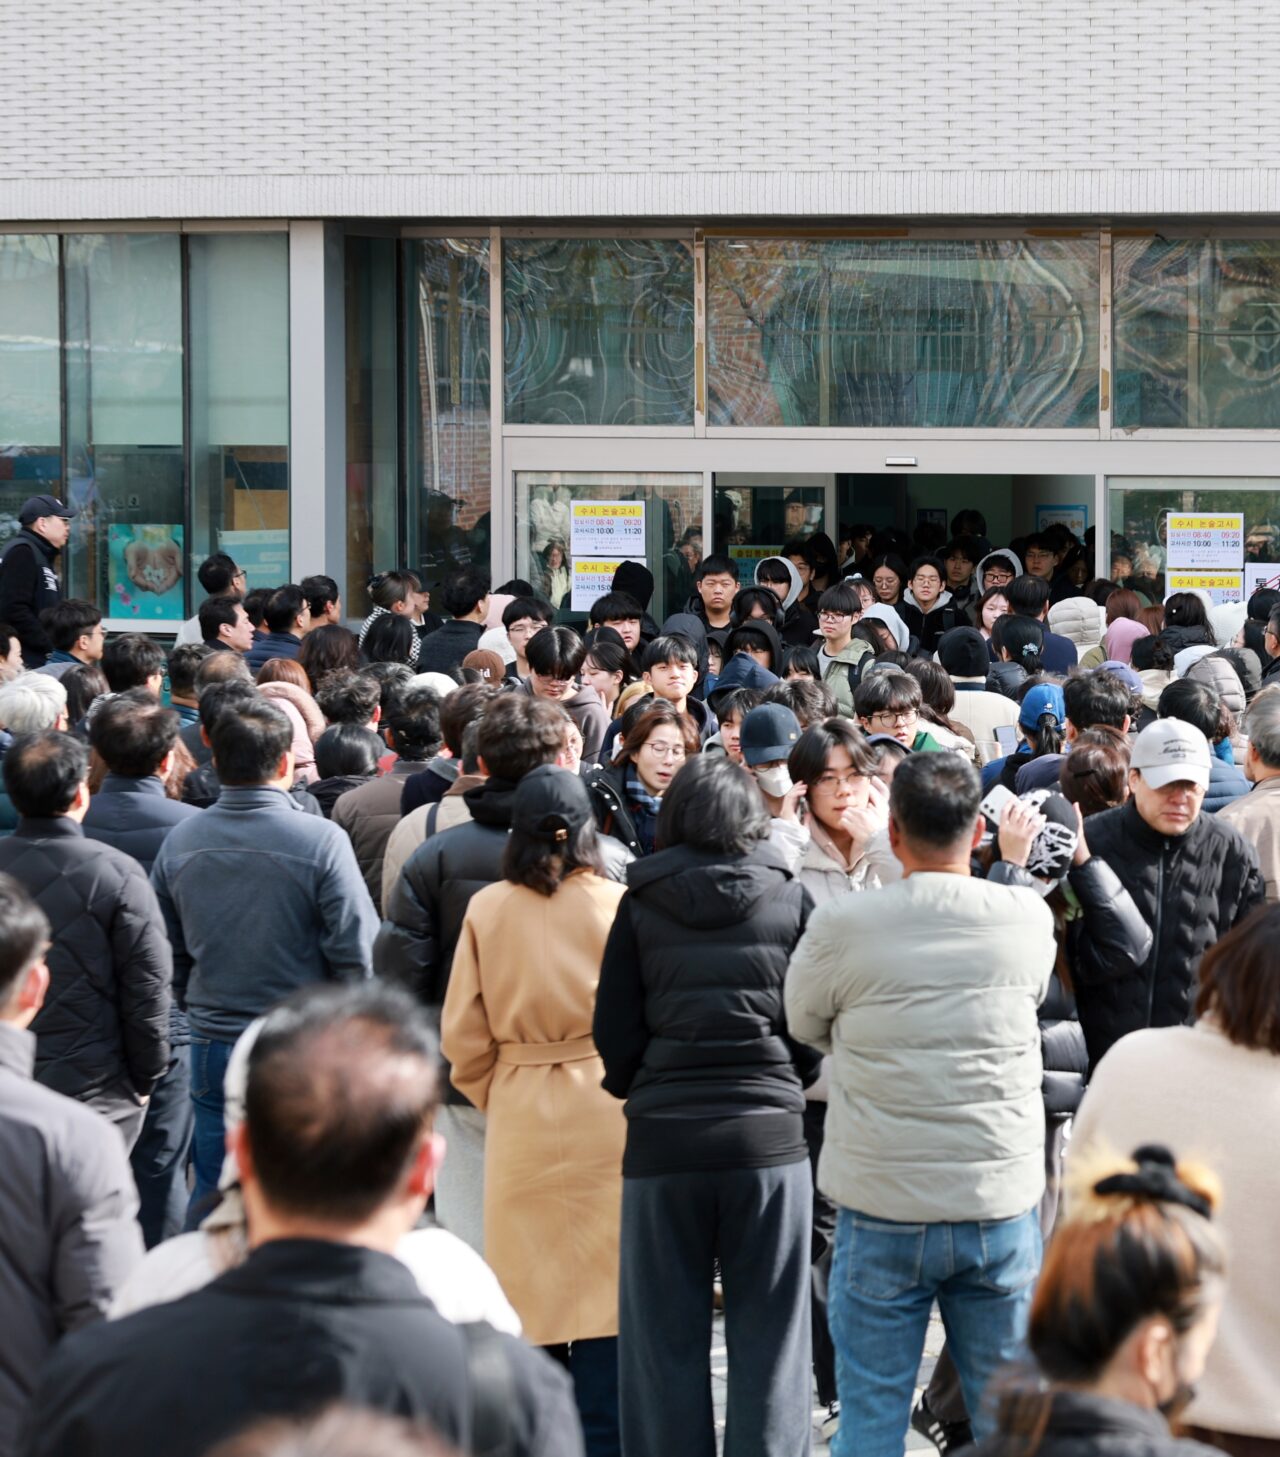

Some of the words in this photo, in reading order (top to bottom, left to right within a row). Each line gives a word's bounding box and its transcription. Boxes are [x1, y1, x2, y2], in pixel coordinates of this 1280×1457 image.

[580, 507, 597, 516] 수시
[602, 507, 635, 516] 논술고사
[1176, 520, 1194, 528] 수시
[1199, 520, 1234, 528] 논술고사
[1192, 531, 1212, 539] 08:40
[1221, 531, 1241, 539] 09:20
[582, 564, 598, 573] 수시
[1176, 578, 1194, 587] 수시
[1199, 578, 1234, 587] 논술고사
